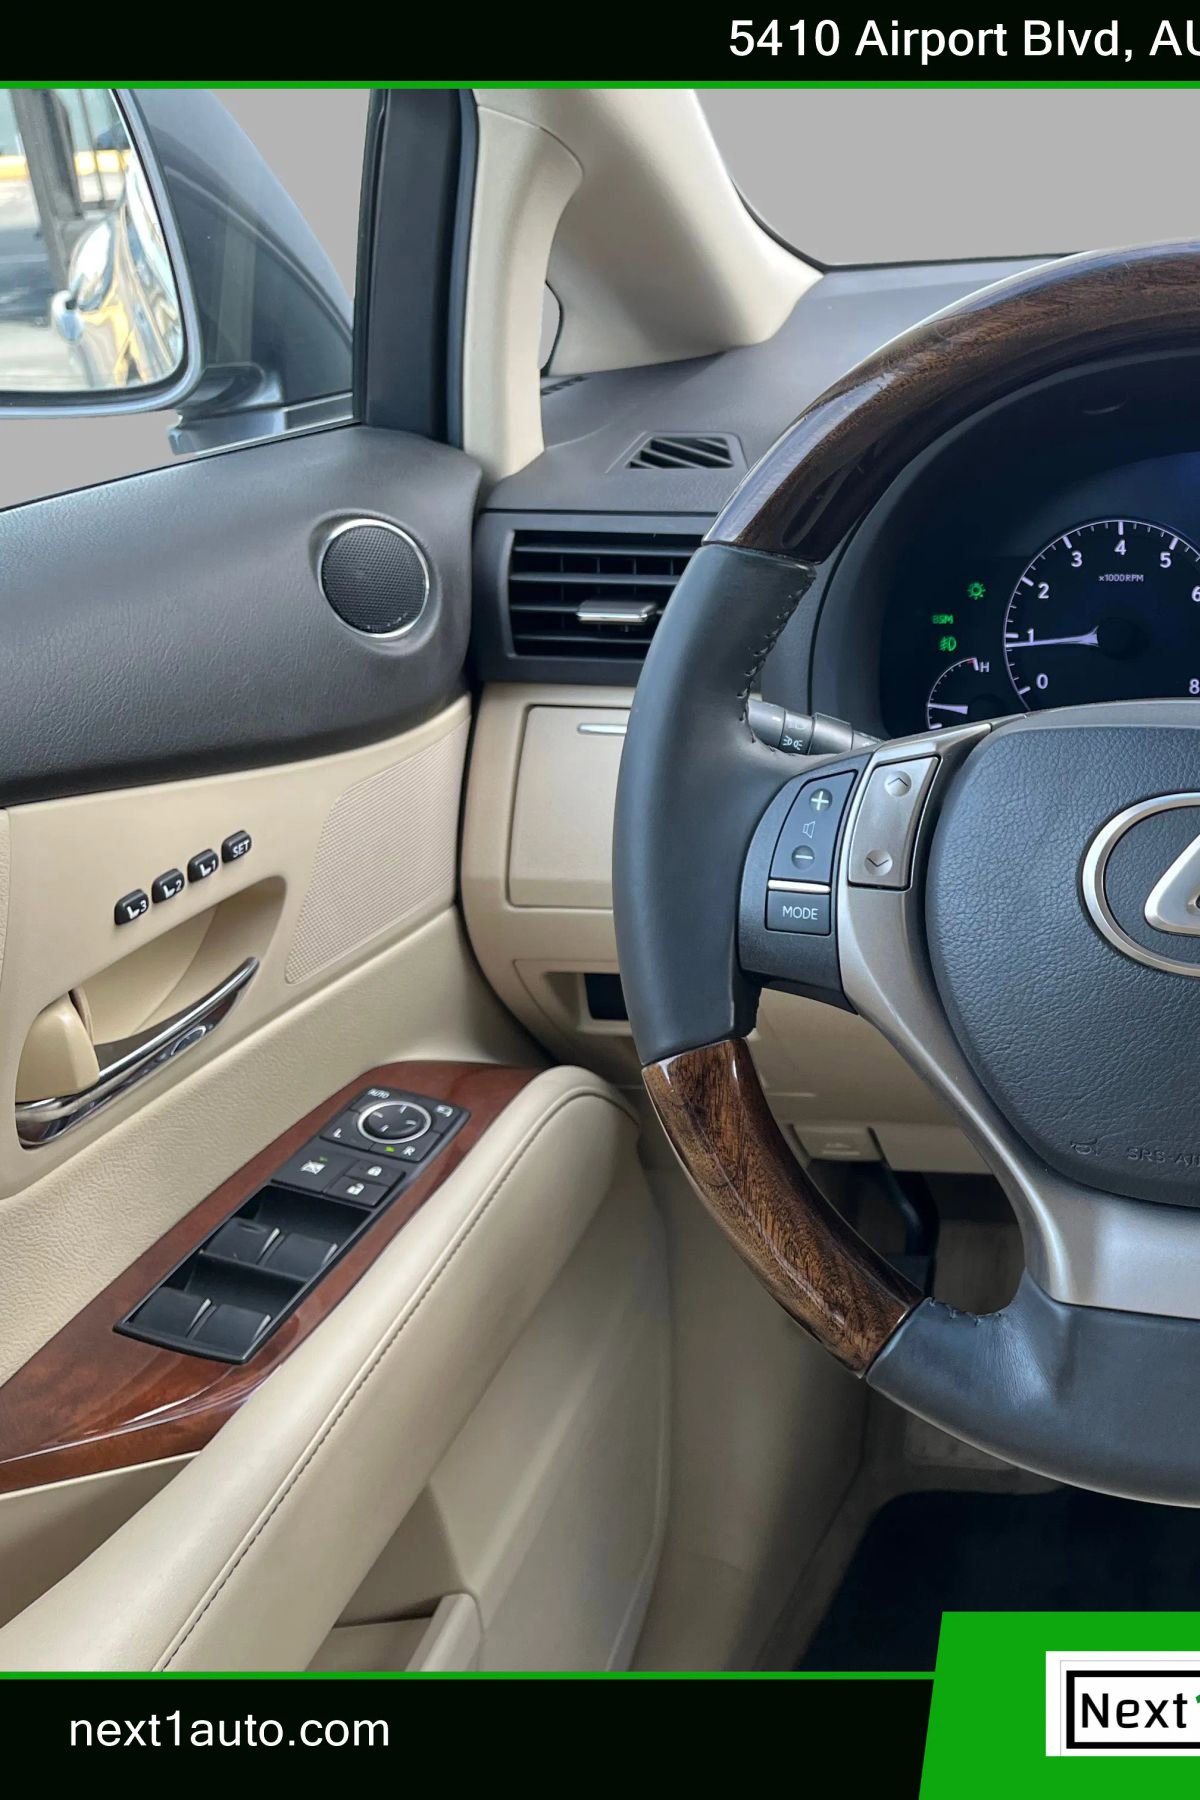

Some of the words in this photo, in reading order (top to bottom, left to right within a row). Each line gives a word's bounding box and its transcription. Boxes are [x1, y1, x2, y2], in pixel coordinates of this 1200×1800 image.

[1115, 541, 1126, 555] 4
[1072, 552, 1082, 567] 3
[1160, 553, 1171, 568] 5
[1038, 584, 1049, 598] 2
[1027, 629, 1035, 643] 1
[980, 661, 989, 672] H
[1036, 674, 1048, 689] 0
[1189, 679, 1200, 694] 8
[232, 839, 250, 858] SET
[782, 906, 818, 920] MODE
